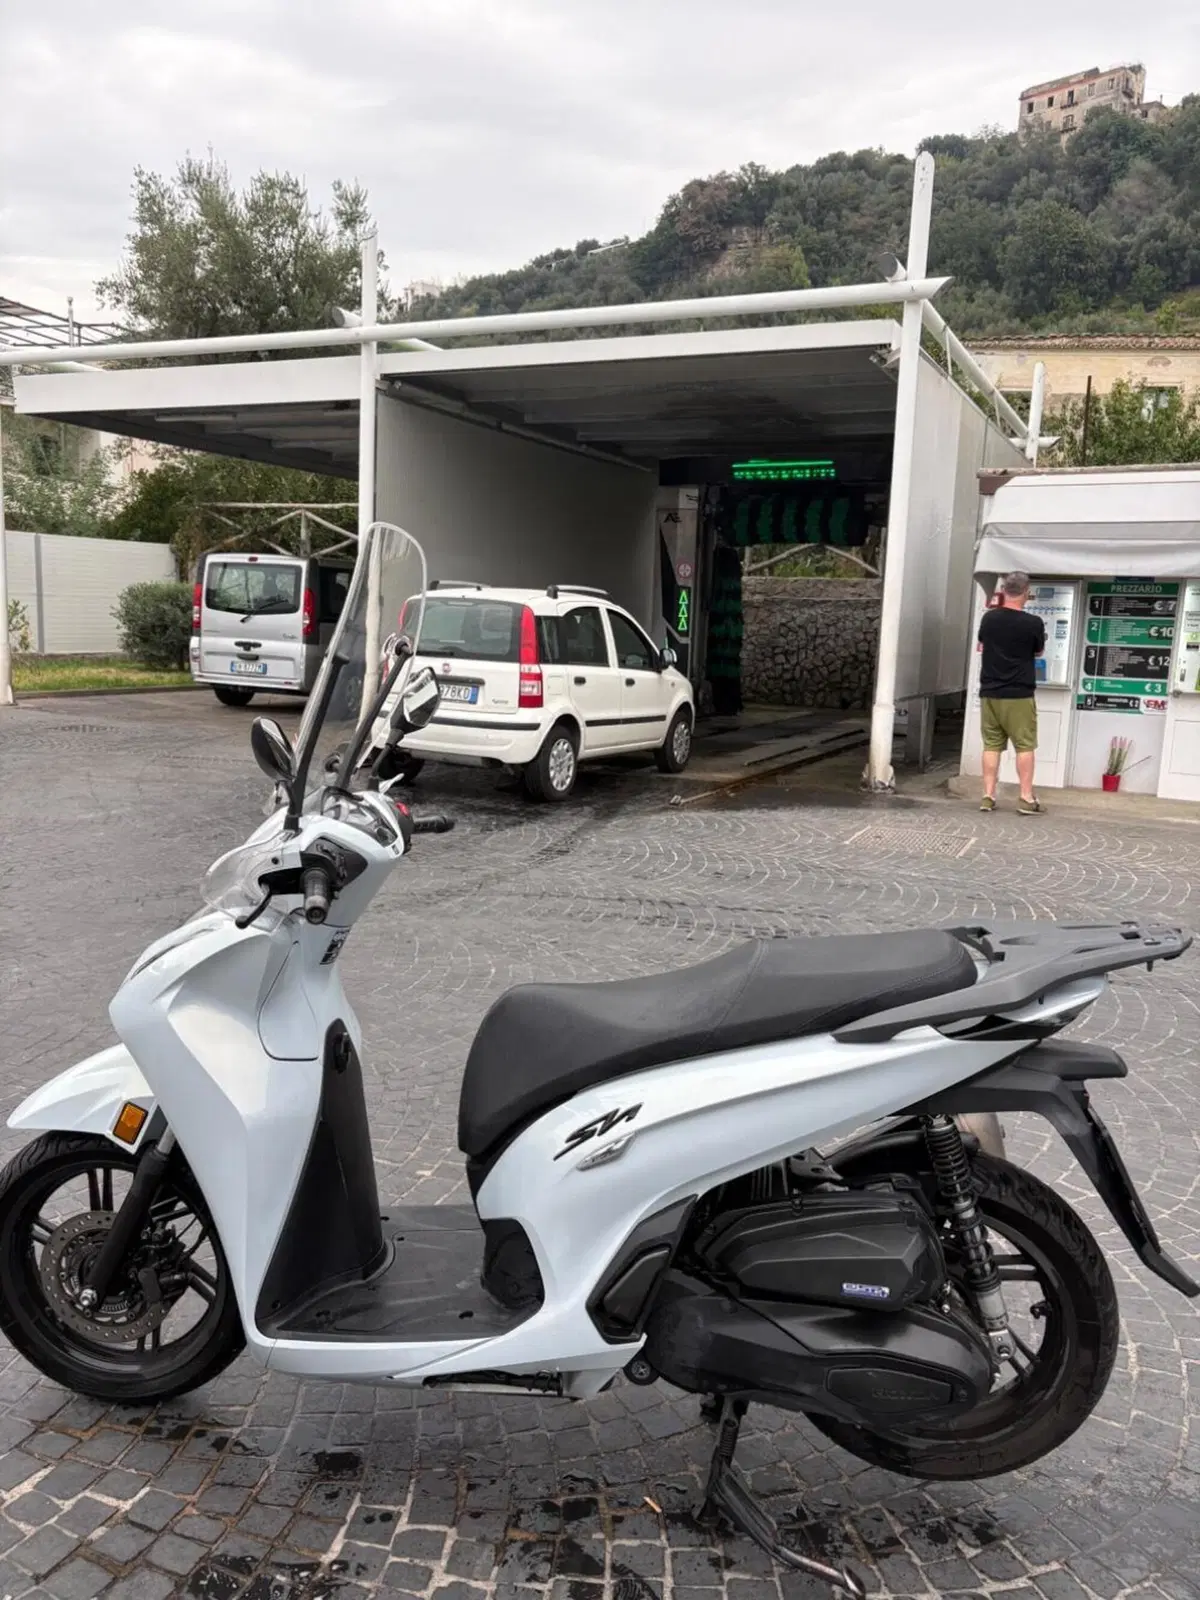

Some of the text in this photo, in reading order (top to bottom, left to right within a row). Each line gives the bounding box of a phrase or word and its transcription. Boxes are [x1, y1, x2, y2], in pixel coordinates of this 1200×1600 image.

[1110, 585, 1162, 593] PREZZARIO
[1168, 601, 1177, 610] 7
[1091, 622, 1098, 631] 2
[1088, 650, 1095, 658] 3
[1154, 684, 1162, 693] 3
